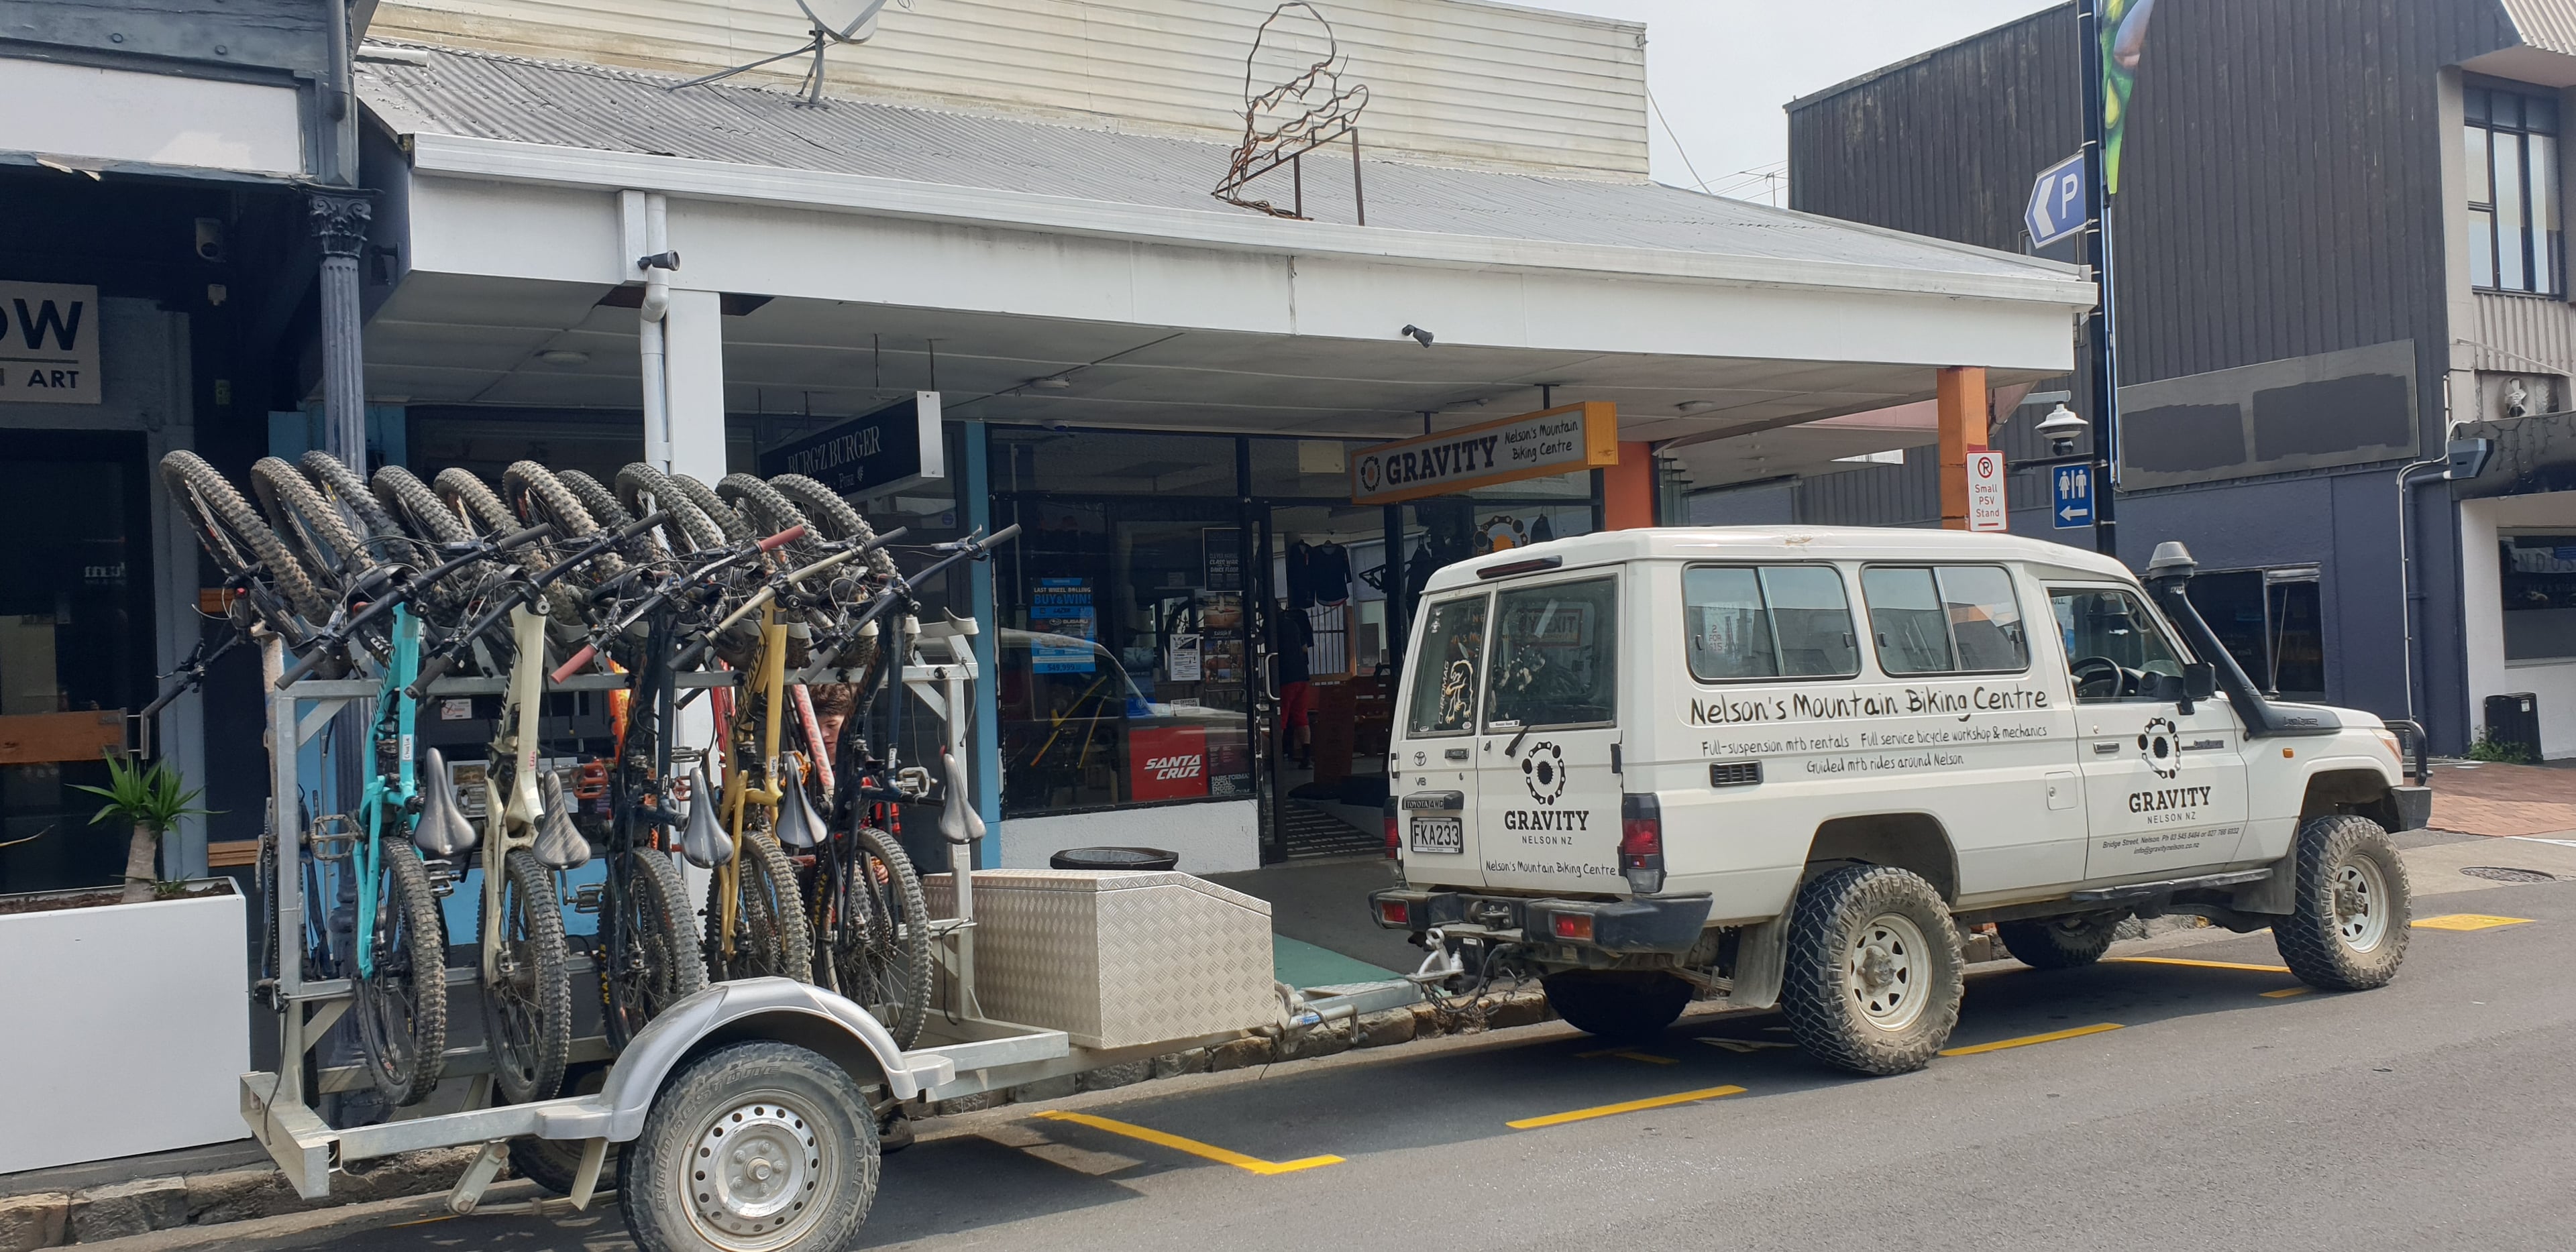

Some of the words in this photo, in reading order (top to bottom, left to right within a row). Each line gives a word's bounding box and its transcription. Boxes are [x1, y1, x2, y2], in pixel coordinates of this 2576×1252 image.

[2061, 173, 2078, 219] P
[0, 298, 83, 351] W
[27, 369, 79, 388] ART
[1505, 427, 1537, 445] Nelson's
[1539, 419, 1578, 437] Mountain
[829, 425, 881, 467] BURGER
[1512, 446, 1537, 462] Biking
[1540, 439, 1572, 455] Centre
[1385, 435, 1498, 486] GRAVITY
[1975, 484, 1997, 493] Small
[1979, 496, 1994, 505] PSV
[1976, 508, 2000, 517] Stand
[1438, 660, 1449, 724] CHROMAG
[1691, 694, 1786, 725] Nelson's
[1793, 689, 1898, 719] Mountain
[1905, 685, 1971, 722] Biking
[1974, 683, 2048, 710] Centre
[1702, 738, 1782, 756] Full-suspension
[1786, 736, 1807, 752] mtb
[1811, 733, 1849, 750] rentals
[1861, 732, 1878, 748] Full
[1881, 732, 1914, 745] service
[1917, 728, 1949, 746] bicycle
[1951, 726, 1991, 742] workshop
[1993, 726, 2000, 739] &
[2002, 723, 2047, 738] mechanics
[1144, 754, 1201, 771] SANTA
[1156, 765, 1202, 781] CRUZ
[1807, 758, 1844, 774] Guided
[1847, 756, 1868, 772] mtb
[1870, 754, 1895, 770] rides
[1898, 752, 1931, 768] around
[1934, 751, 1964, 766] Nelson
[1415, 777, 1426, 786] V8
[1407, 800, 1429, 808] TOYOTA
[1430, 800, 1444, 808] 4WD
[2129, 786, 2210, 813] GRAVITY
[1505, 811, 1589, 831] GRAVITY
[2147, 813, 2182, 824] NELSON
[2186, 811, 2196, 820] NZ
[1413, 824, 1459, 846] FKA233
[1522, 836, 1557, 844] NELSON
[1561, 837, 1572, 845] NZ
[2102, 840, 2121, 850] Bridge
[1486, 860, 1515, 872] Nelson's
[1517, 860, 1555, 873] Mountain
[1556, 862, 1580, 878] Biking
[1583, 863, 1616, 876] Centre
[813, 873, 827, 925] MAXXIS
[655, 1064, 782, 1214] BRIDGESTONE
